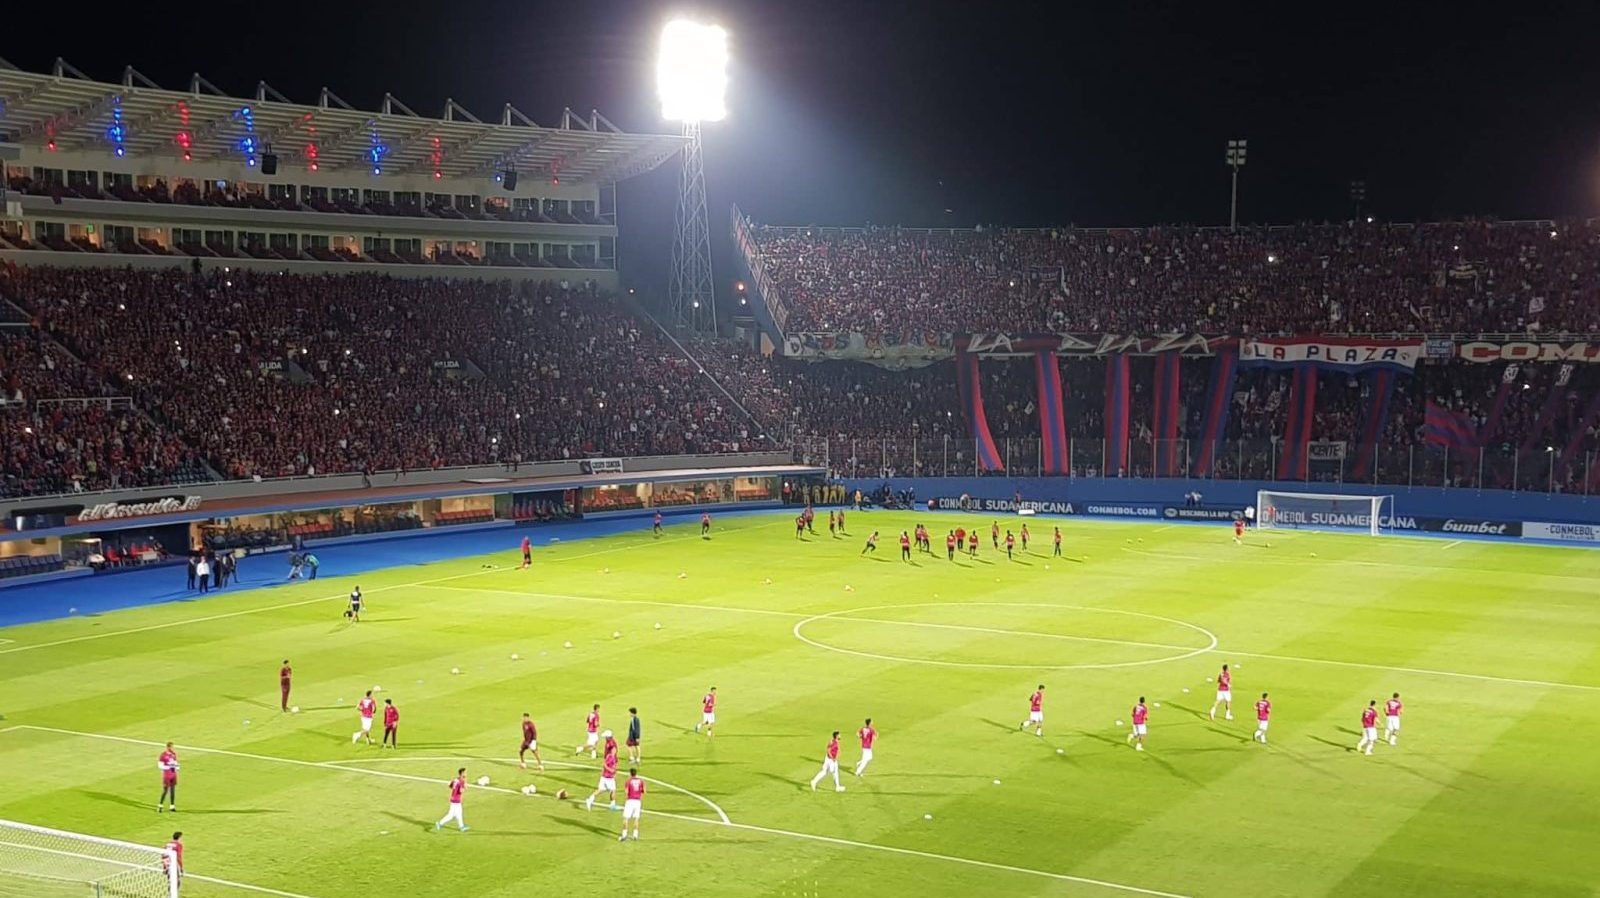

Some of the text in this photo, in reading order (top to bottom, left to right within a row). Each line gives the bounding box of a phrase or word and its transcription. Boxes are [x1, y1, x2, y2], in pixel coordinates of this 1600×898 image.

[1255, 344, 1398, 362] LA PLAZA
[1087, 505, 1157, 516] CONMEBOL.COM
[1311, 512, 1417, 529] SUDAMERCANA
[1442, 518, 1508, 535] bumbet
